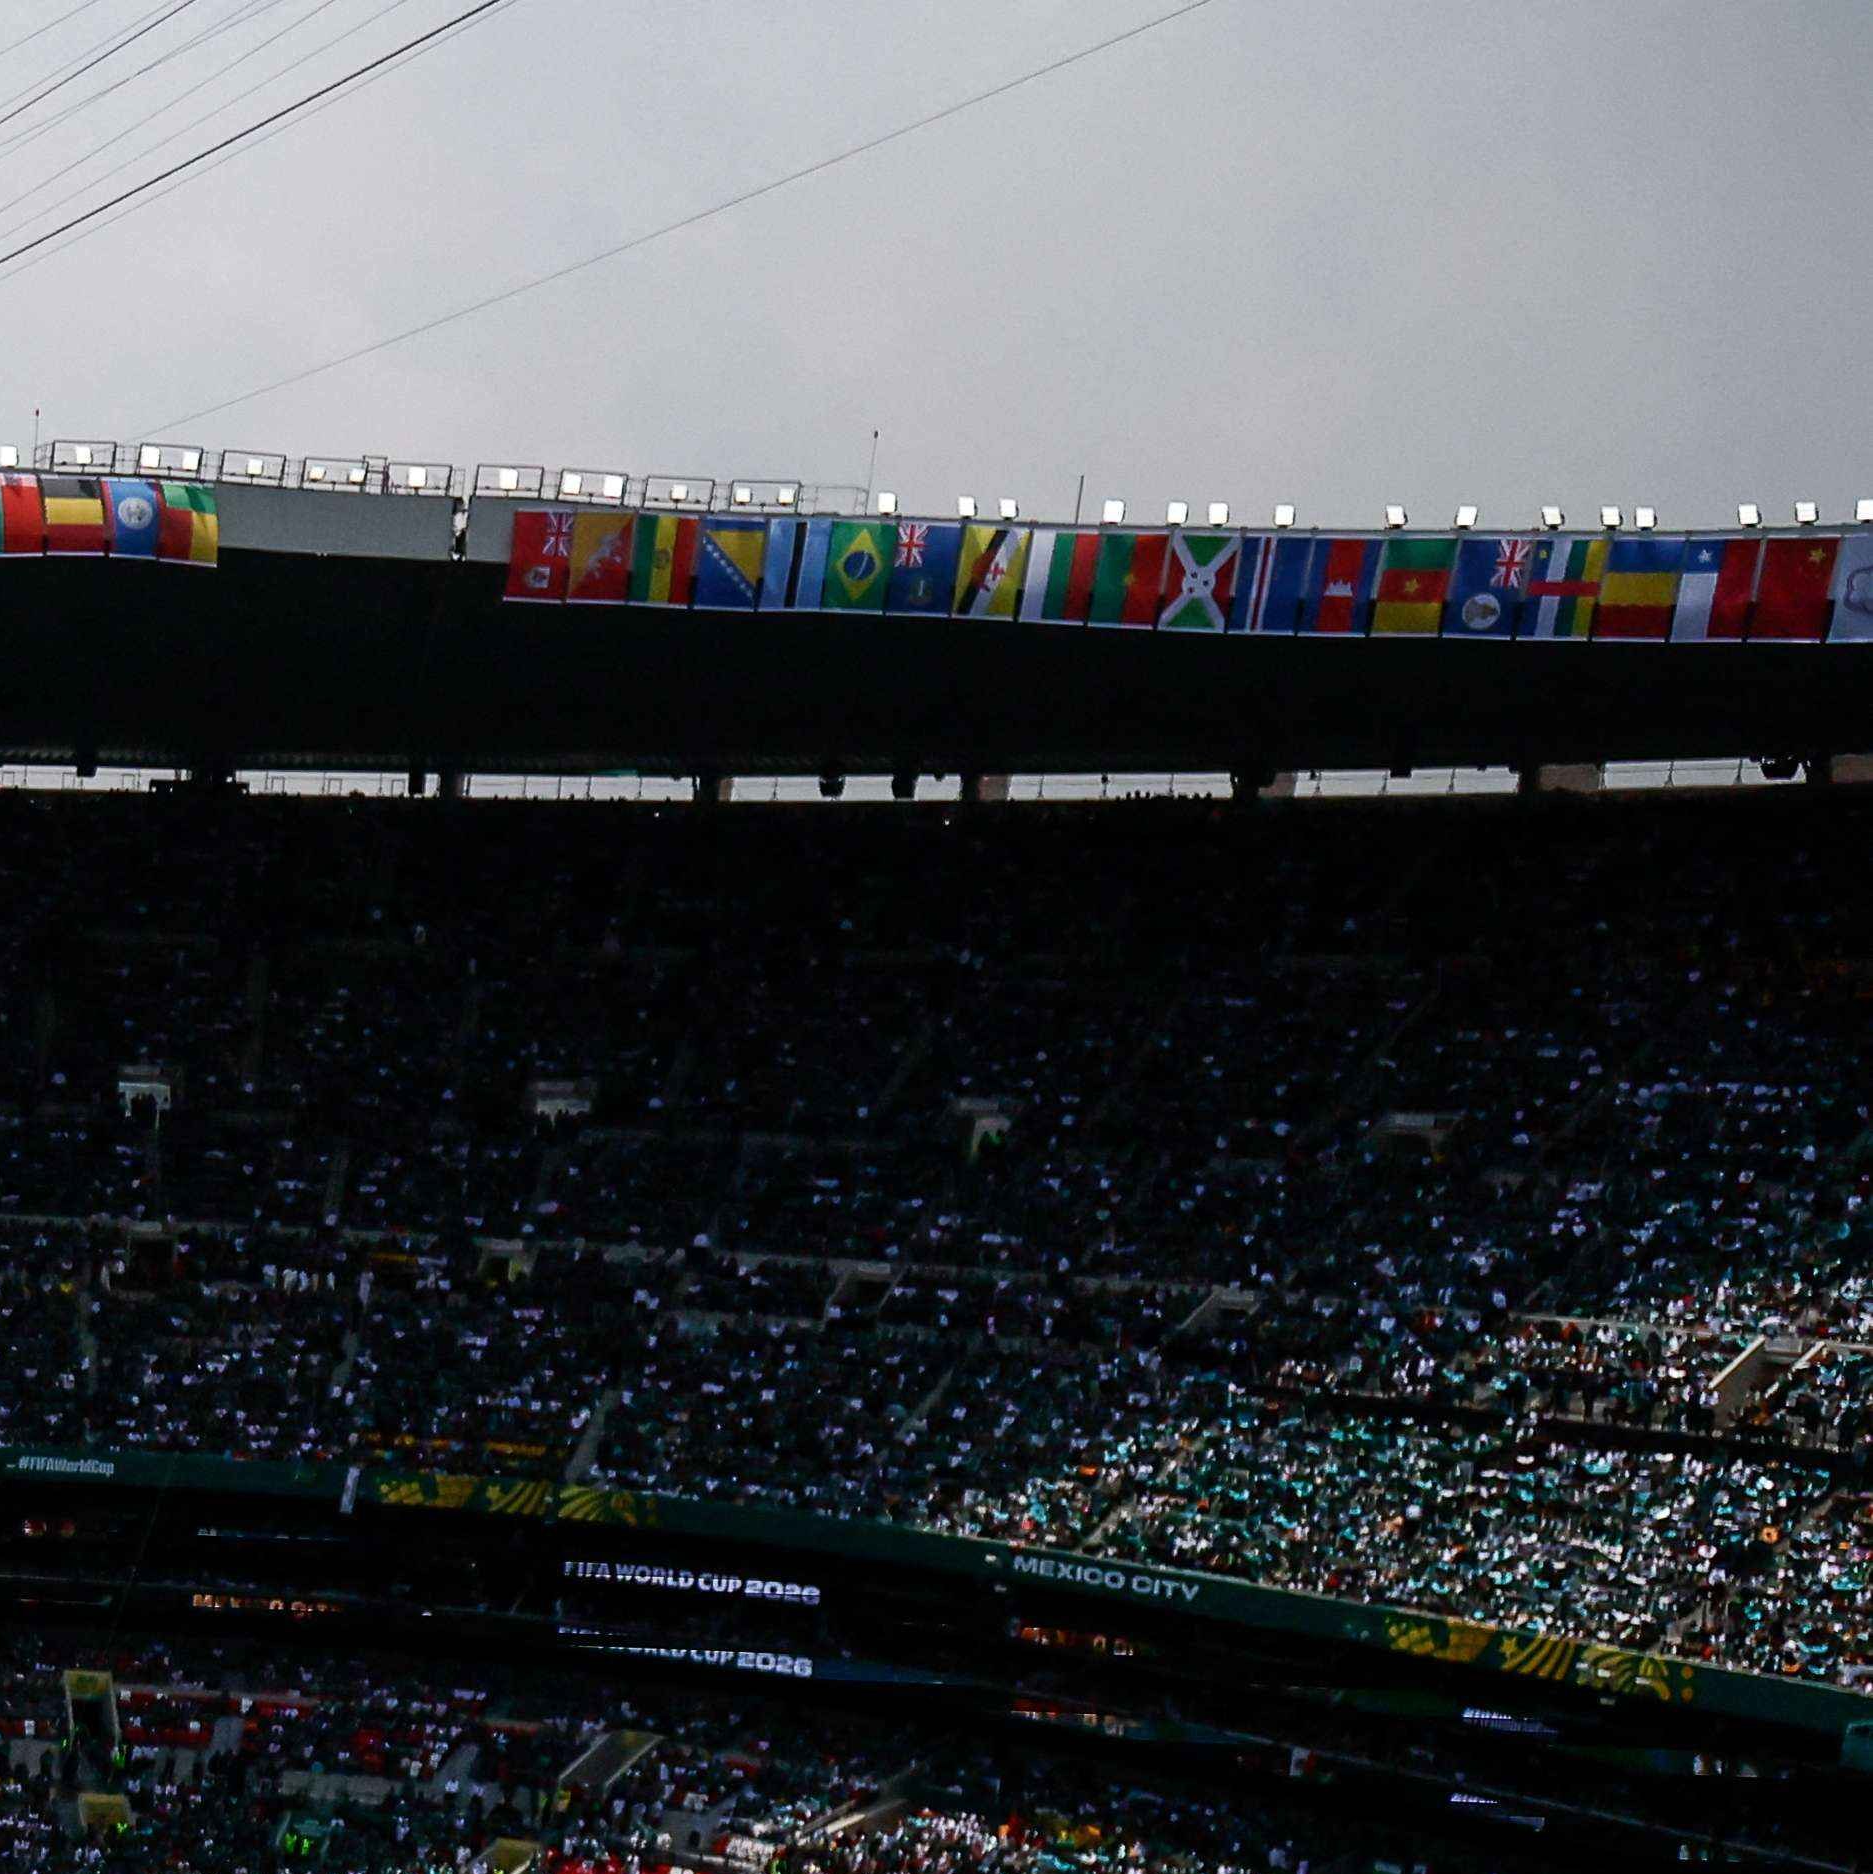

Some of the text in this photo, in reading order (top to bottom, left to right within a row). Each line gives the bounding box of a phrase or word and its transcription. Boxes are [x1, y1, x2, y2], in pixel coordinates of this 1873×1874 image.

[564, 1560, 612, 1580] FIFA
[614, 1563, 695, 1589] WORLD
[697, 1571, 743, 1595] CUP
[1012, 1554, 1200, 1604] MEXICO CITY
